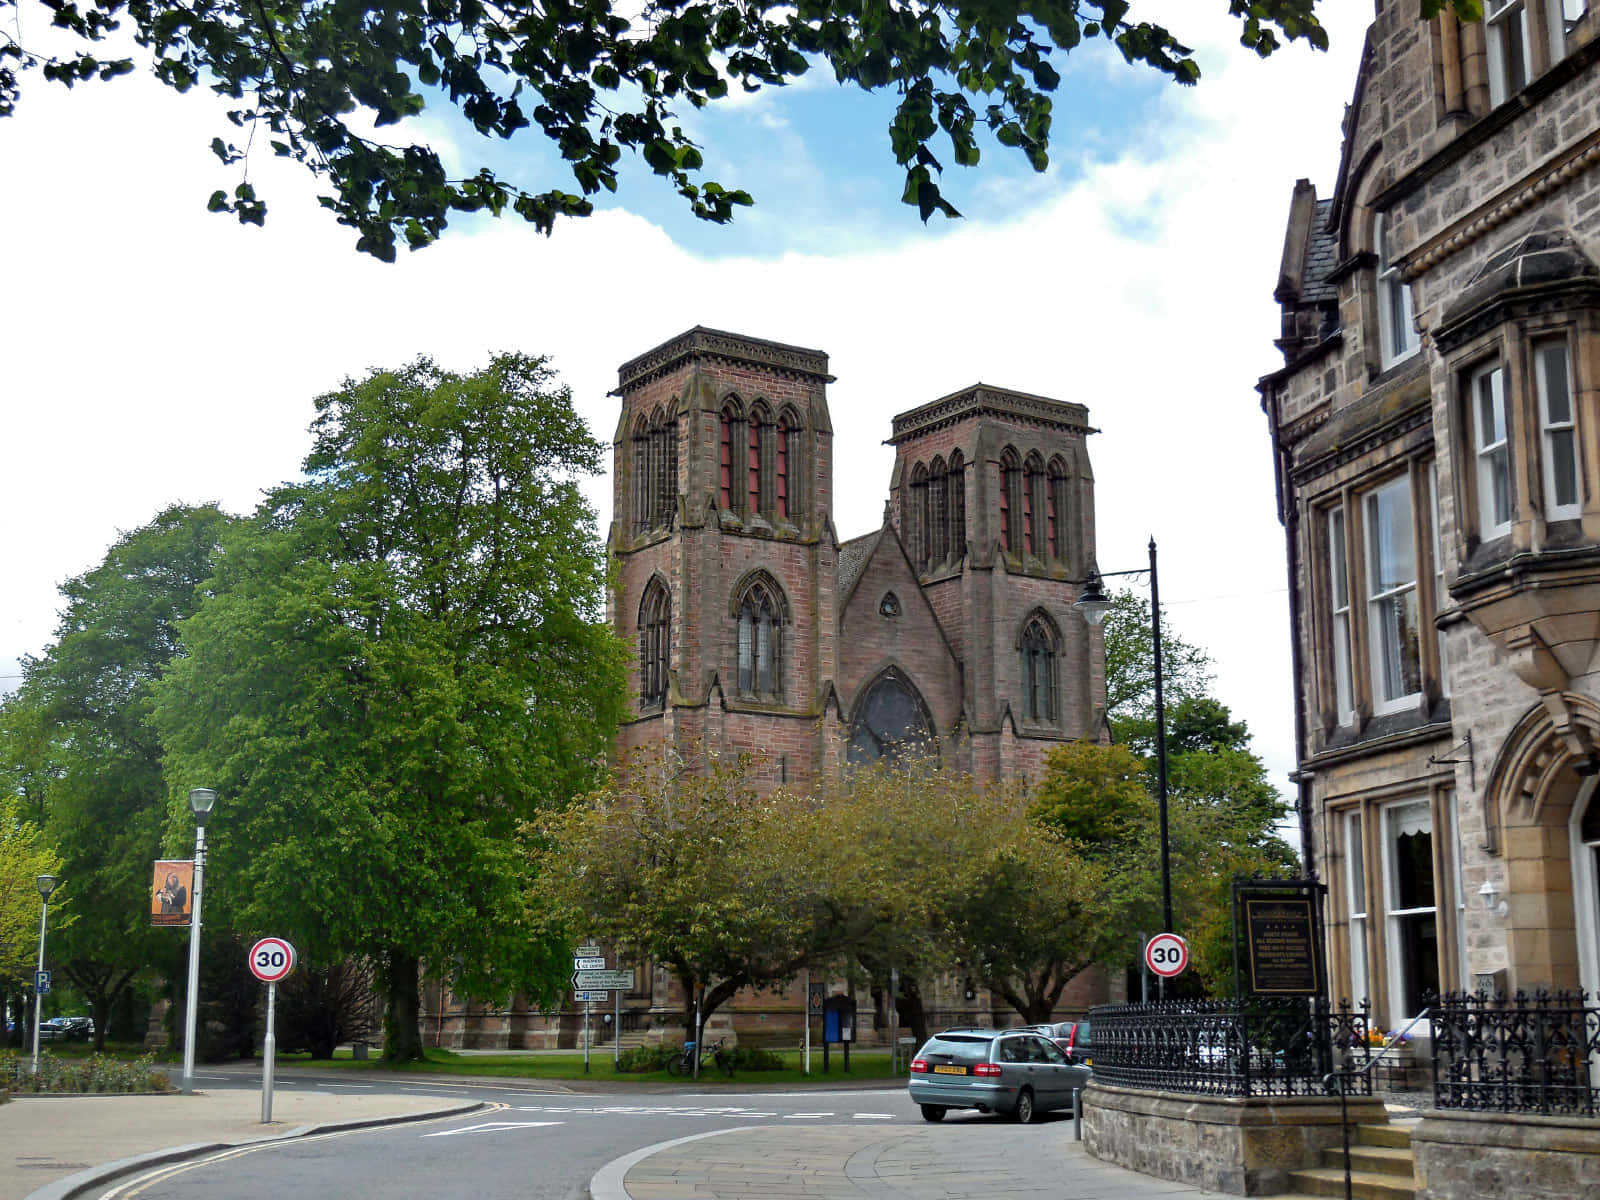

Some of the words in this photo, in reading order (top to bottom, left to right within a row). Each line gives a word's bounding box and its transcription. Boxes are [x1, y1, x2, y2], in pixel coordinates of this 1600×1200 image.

[257, 951, 284, 967] 30
[1154, 947, 1180, 963] 30
[38, 973, 48, 988] P
